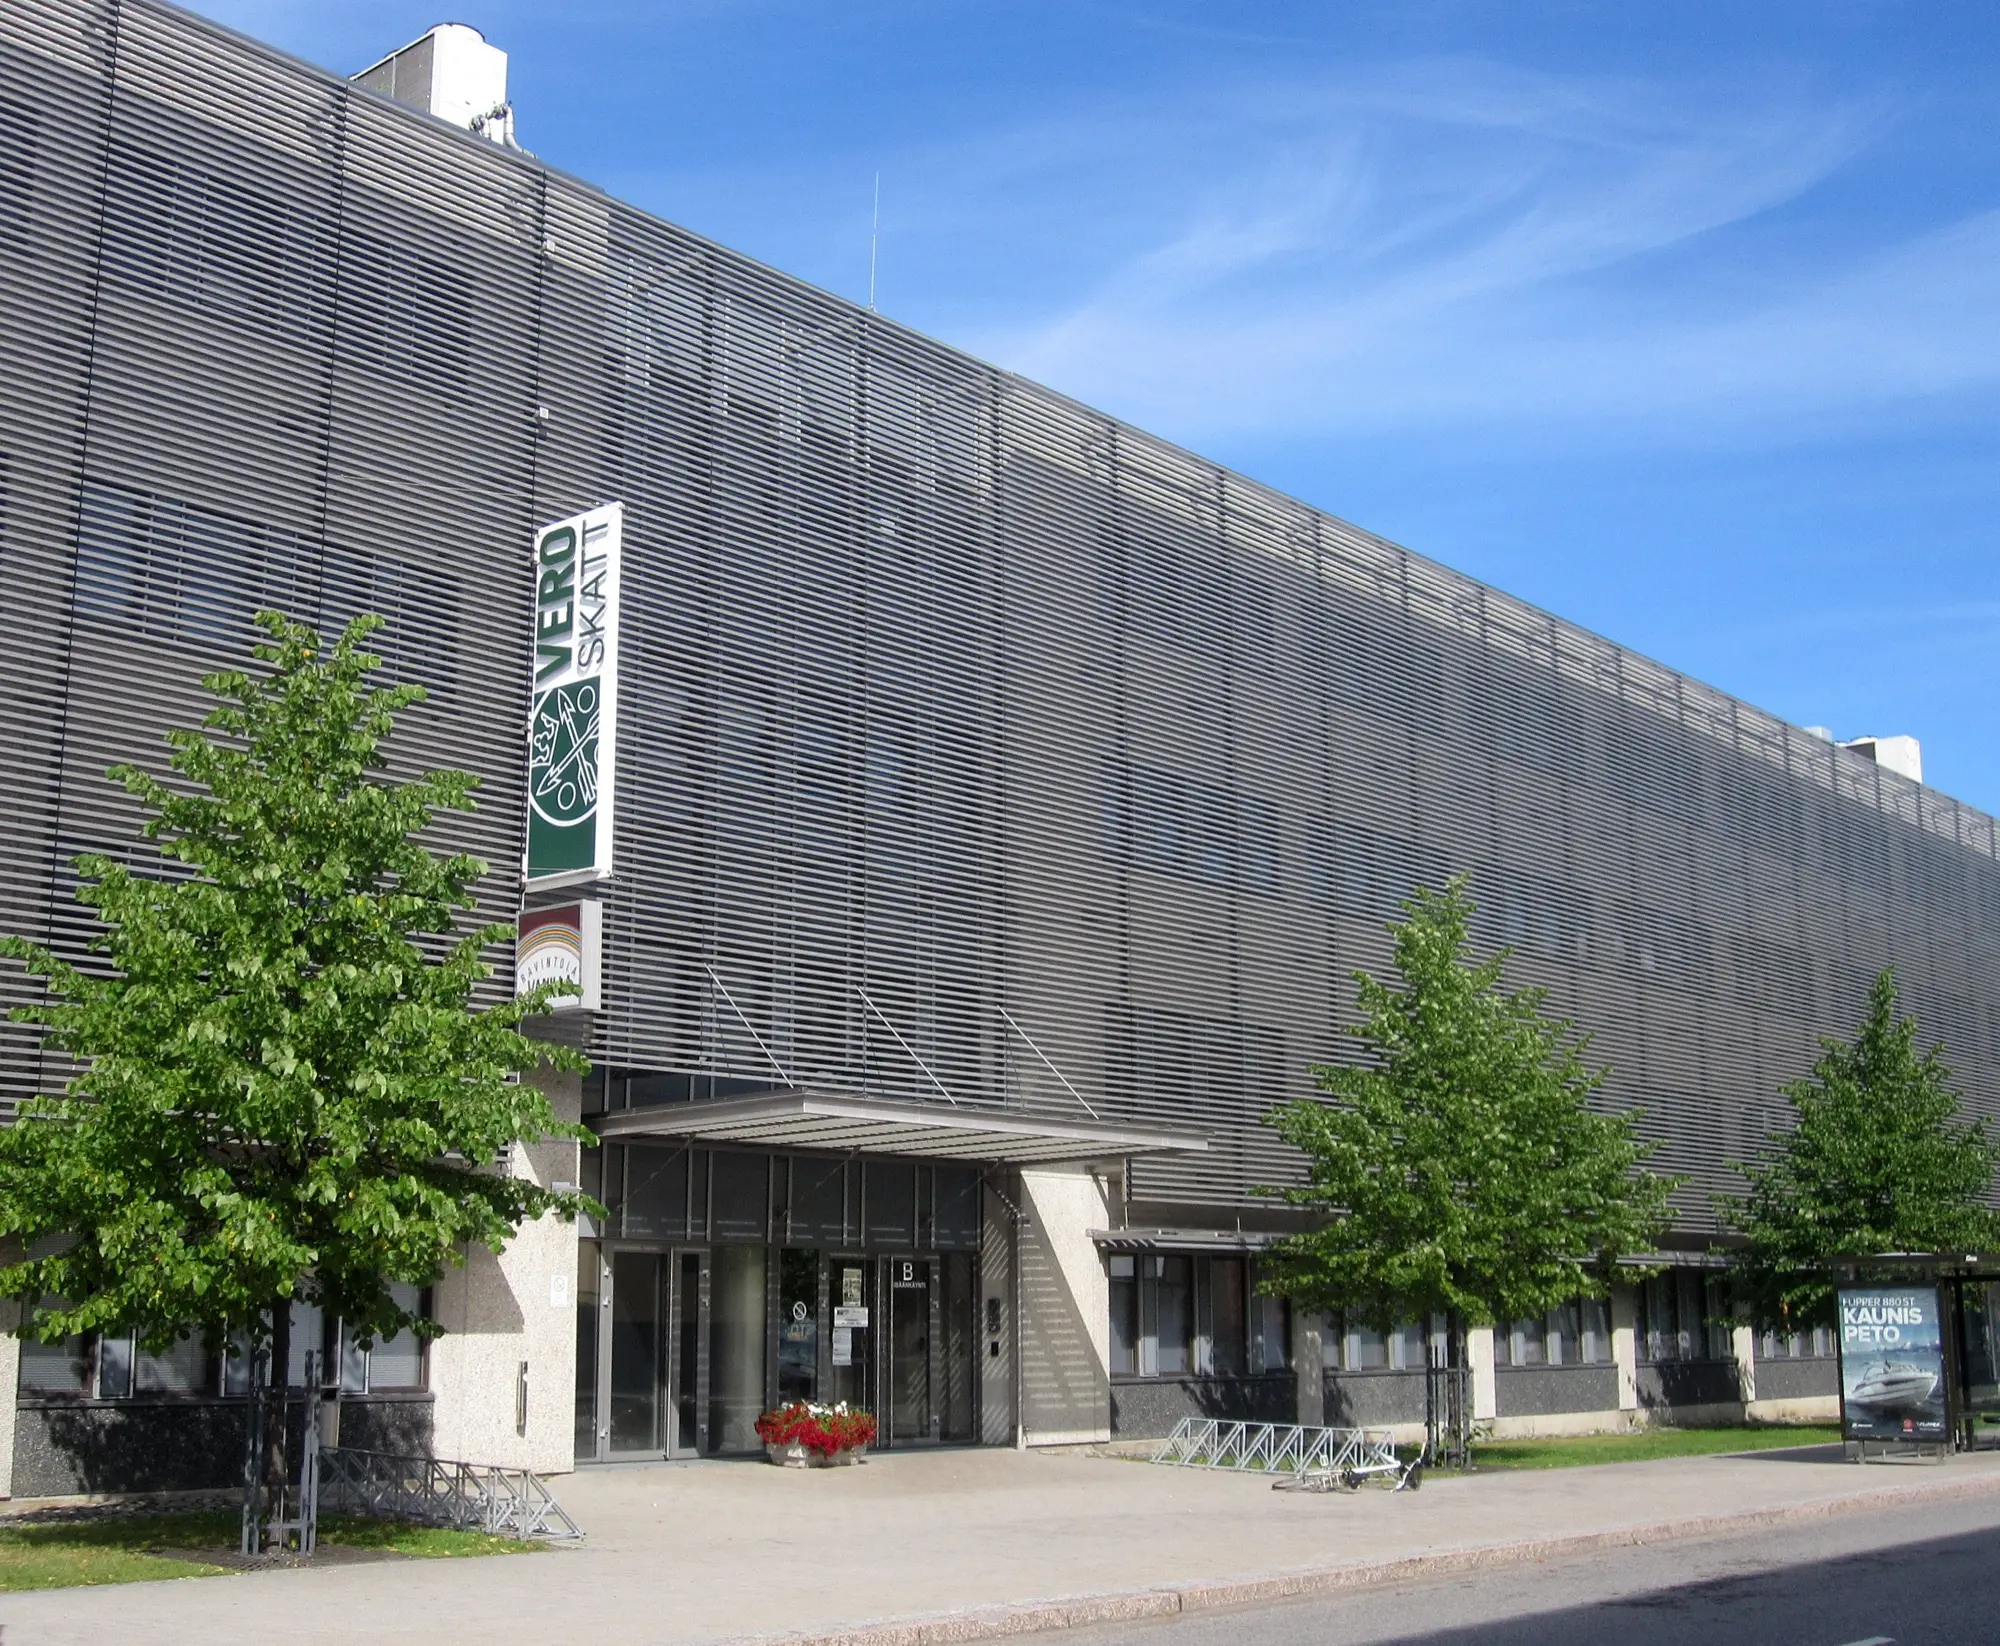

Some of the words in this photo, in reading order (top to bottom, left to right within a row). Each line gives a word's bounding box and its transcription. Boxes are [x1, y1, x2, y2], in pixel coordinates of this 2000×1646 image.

[577, 519, 608, 670] SKATT
[535, 525, 577, 686] VERO
[520, 956, 577, 984] RAVINTOLA
[903, 1262, 913, 1281] B
[1842, 1297, 1881, 1307] FLIPPER
[1843, 1307, 1923, 1325] KAUNIS
[1844, 1325, 1900, 1343] PETO
